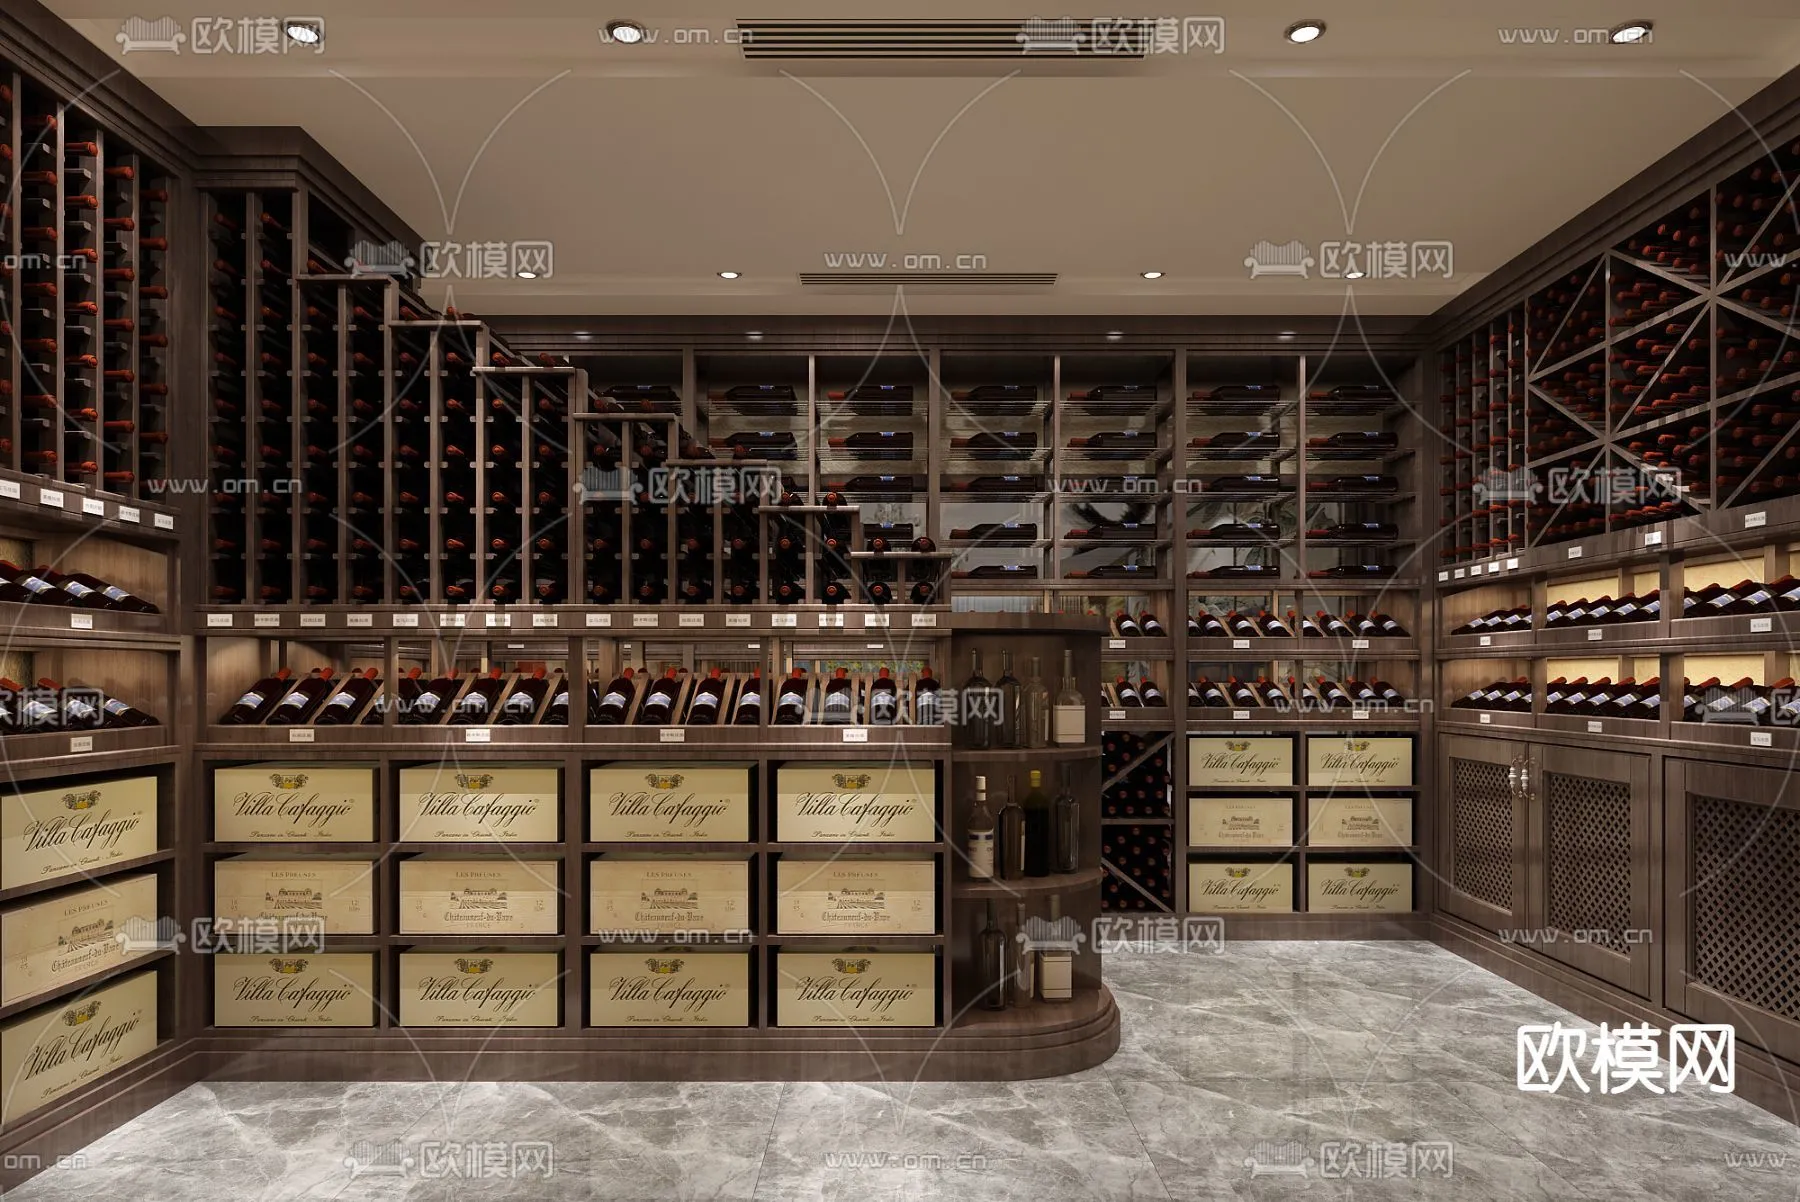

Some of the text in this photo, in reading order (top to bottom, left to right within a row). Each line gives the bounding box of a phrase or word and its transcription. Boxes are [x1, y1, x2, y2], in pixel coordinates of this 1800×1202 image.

[234, 791, 274, 817] Villa
[419, 791, 459, 817] Villa
[610, 791, 650, 817] Villa
[796, 791, 836, 817] Villa
[23, 815, 68, 851] Villa
[234, 976, 274, 1002] Villa
[419, 976, 459, 1002] Villa
[609, 976, 649, 1002] Villa
[796, 976, 836, 1002] Villa
[23, 1035, 68, 1080] Villa
